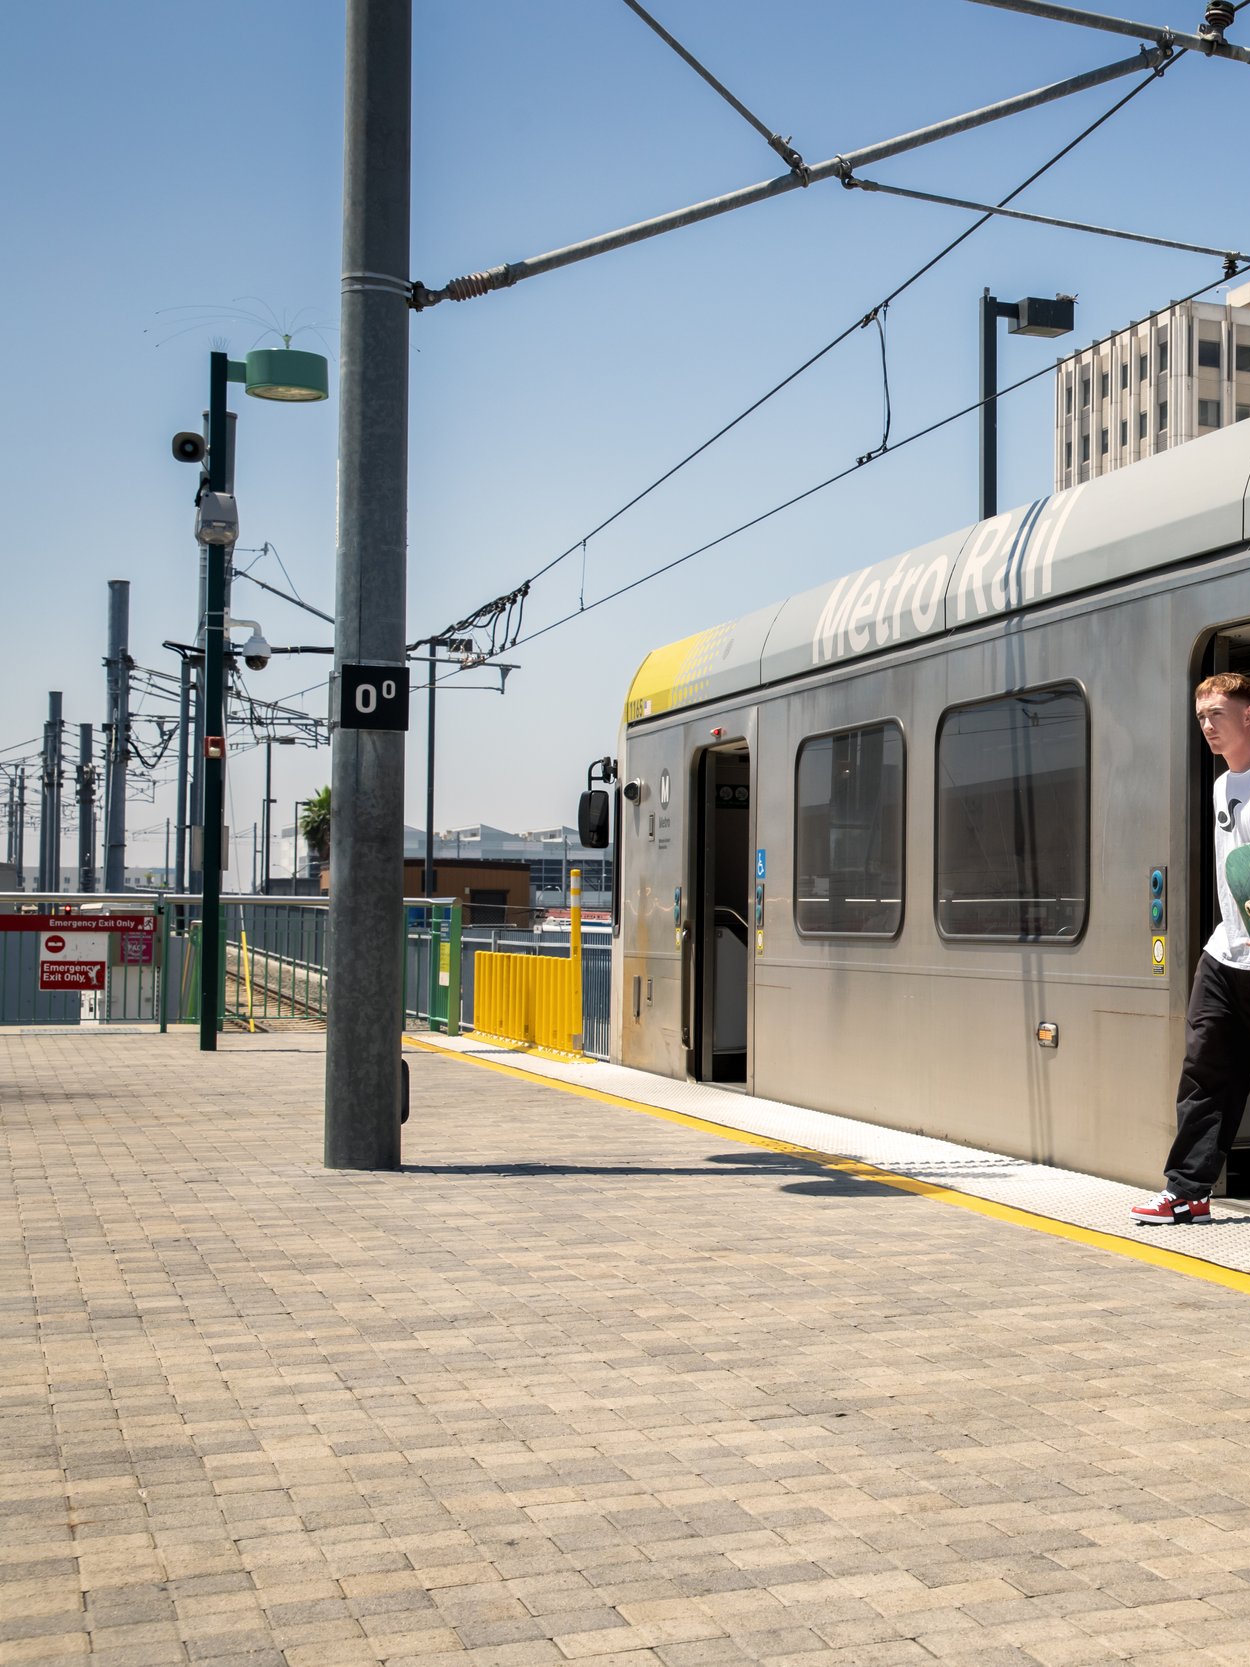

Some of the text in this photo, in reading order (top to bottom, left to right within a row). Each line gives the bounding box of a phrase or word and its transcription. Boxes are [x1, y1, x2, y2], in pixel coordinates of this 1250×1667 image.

[812, 482, 1089, 665] Metro Rail
[49, 919, 136, 928] Emergency Exit Only
[43, 973, 62, 981] Exit
